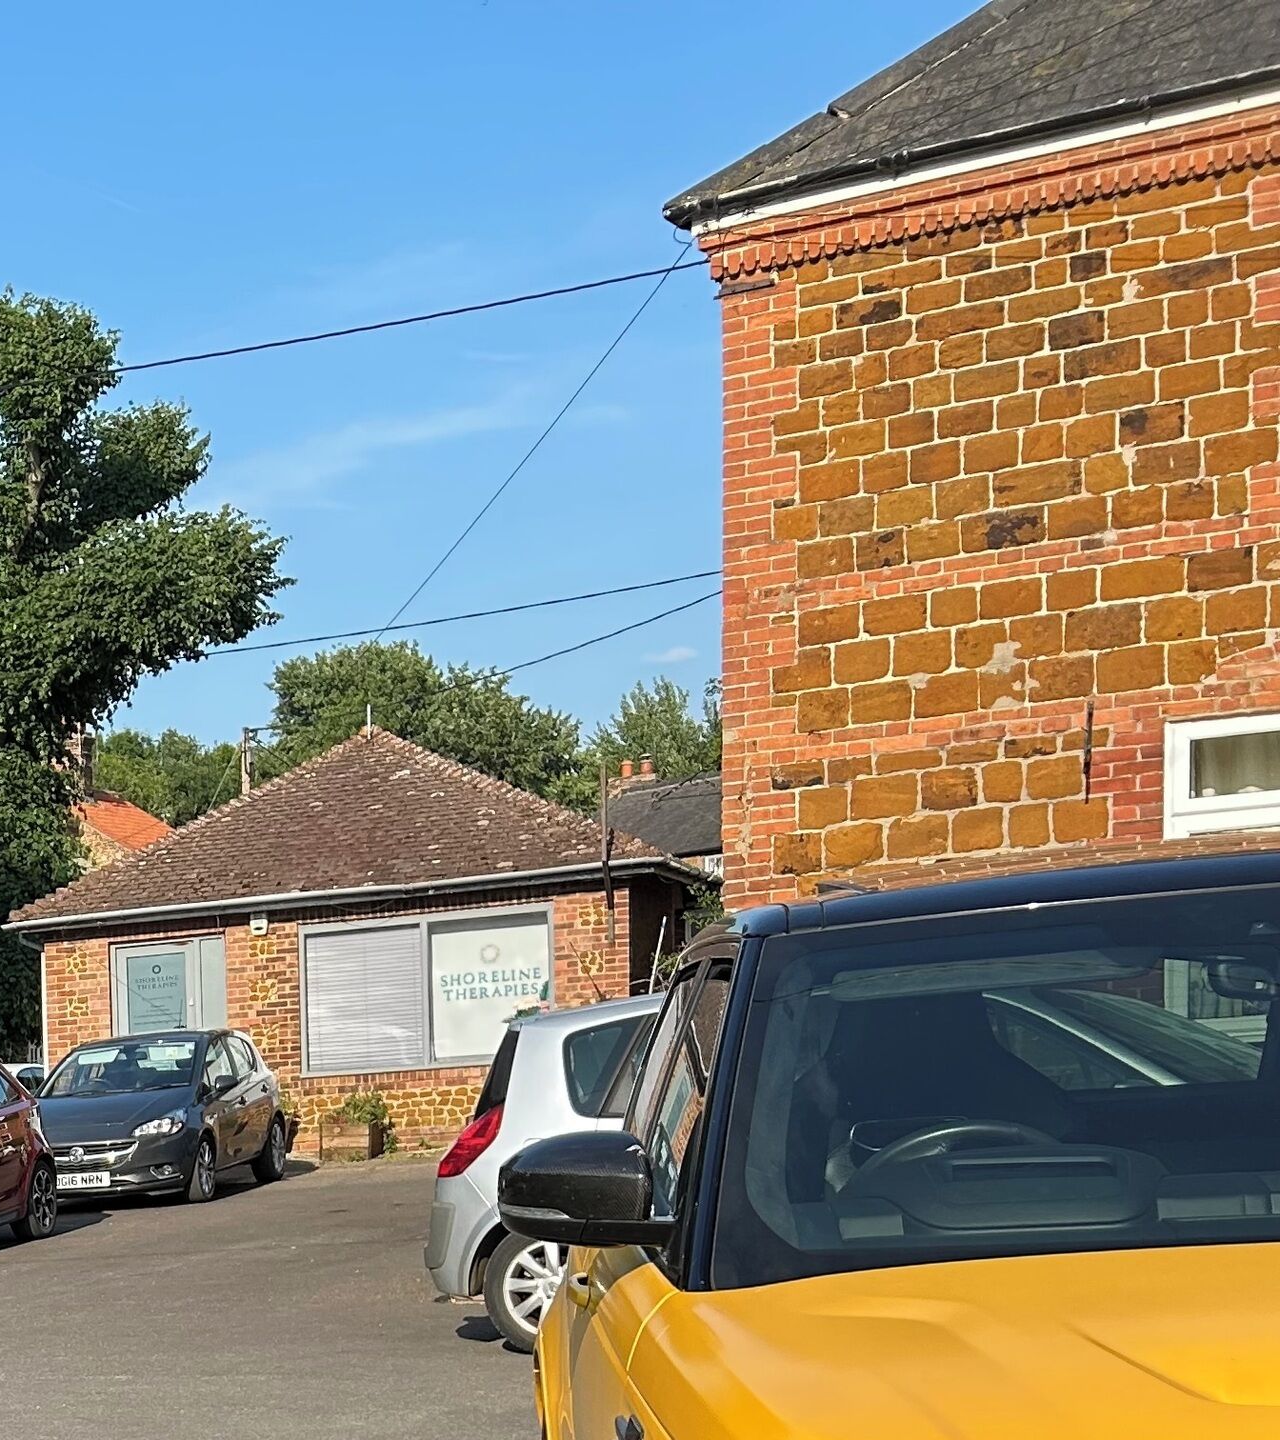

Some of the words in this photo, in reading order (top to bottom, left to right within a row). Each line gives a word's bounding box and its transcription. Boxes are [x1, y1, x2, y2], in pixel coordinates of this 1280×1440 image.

[440, 967, 541, 987] SHORELINE
[443, 983, 539, 1001] THERAPIES
[81, 1174, 102, 1185] NRN
